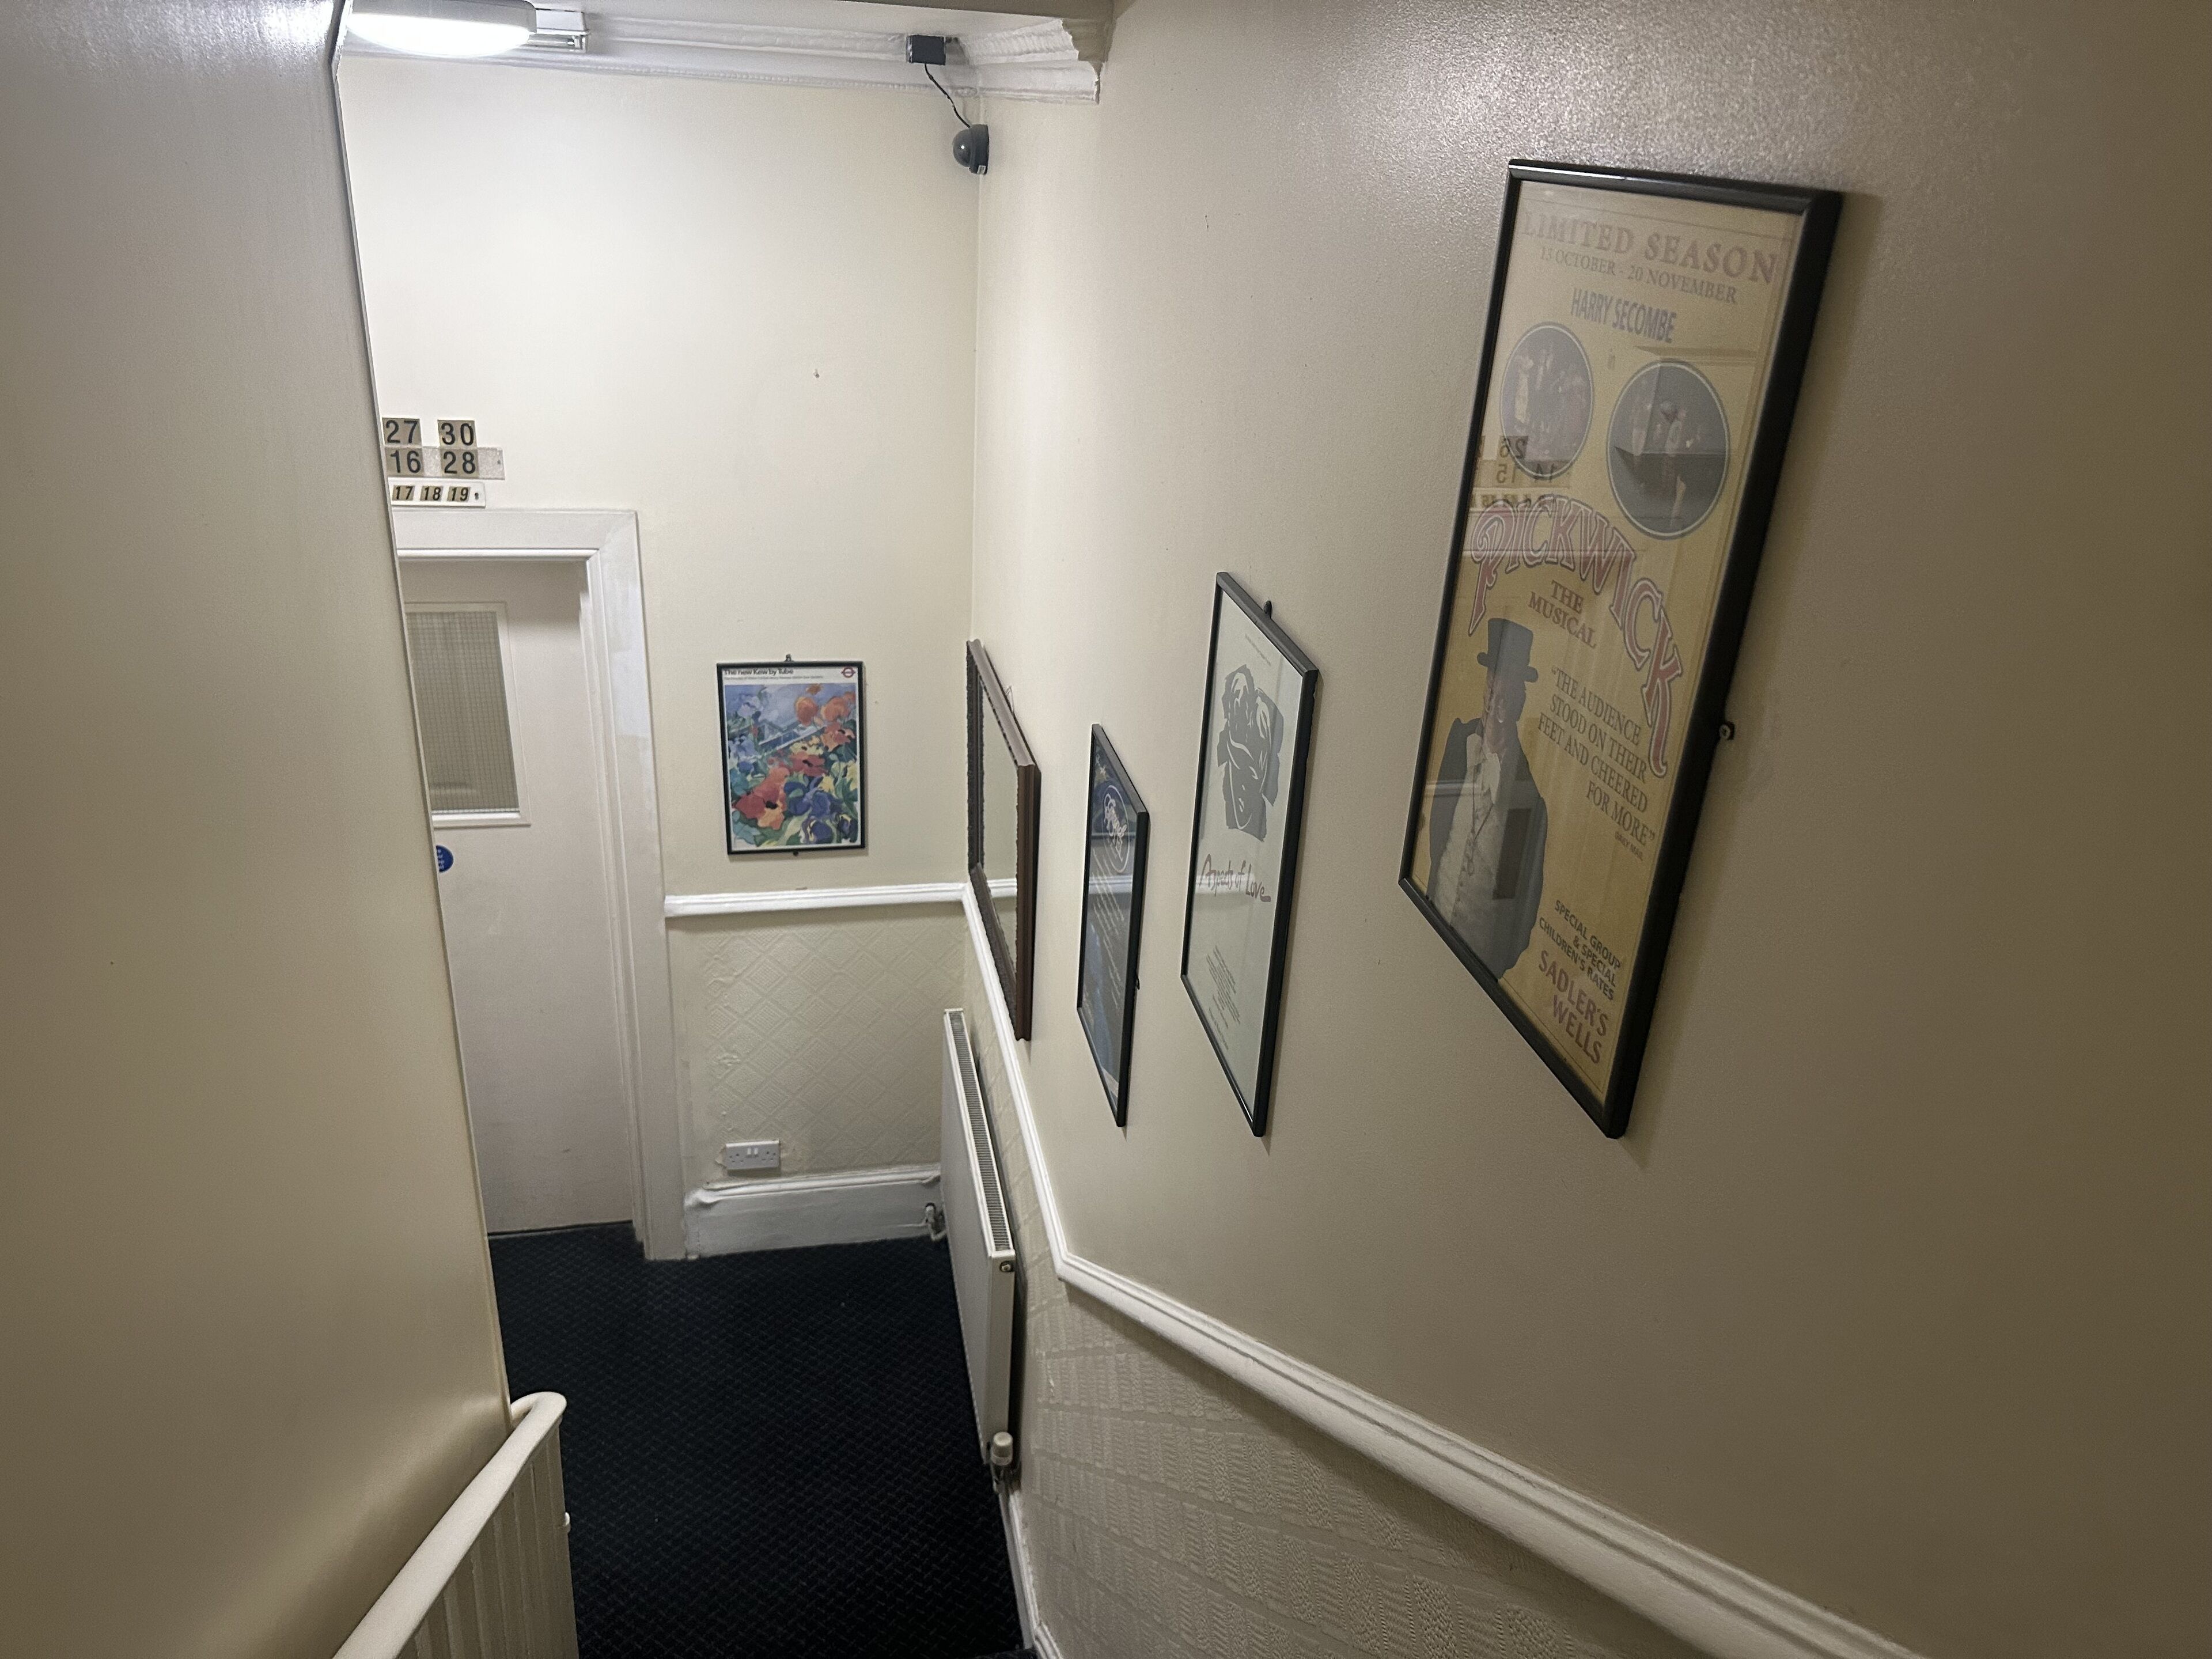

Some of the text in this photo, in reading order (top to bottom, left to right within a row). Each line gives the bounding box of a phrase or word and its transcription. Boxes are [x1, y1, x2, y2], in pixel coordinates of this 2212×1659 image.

[1521, 213, 1778, 284] LIMITED SEASON
[1556, 248, 1616, 276] OCTOBER
[1628, 264, 1643, 281] 20
[1646, 268, 1737, 305] NOVEMBER
[1571, 287, 1677, 343] HARRY SECOMBE
[385, 419, 474, 446] 27 30
[390, 450, 476, 474] 16 28
[396, 486, 469, 501] 17 18 19
[1529, 591, 1597, 649] MUSICAL
[1551, 579, 1584, 615] THE
[1468, 493, 1683, 779] PICKWICK
[769, 668, 777, 676] by
[1550, 694, 1646, 784] STOOD ON THEIR
[1578, 686, 1641, 746] AUDIENCE
[1538, 712, 1648, 813] FEET AND CHEERED
[1586, 780, 1611, 815] FOR
[1199, 853, 1271, 902] Aspects of Love
[1555, 899, 1622, 970] SPECIAL GROUP
[1572, 935, 1616, 988] & SPECIAL
[1586, 966, 1615, 1001] RATES
[1552, 994, 1603, 1064] WELLS
